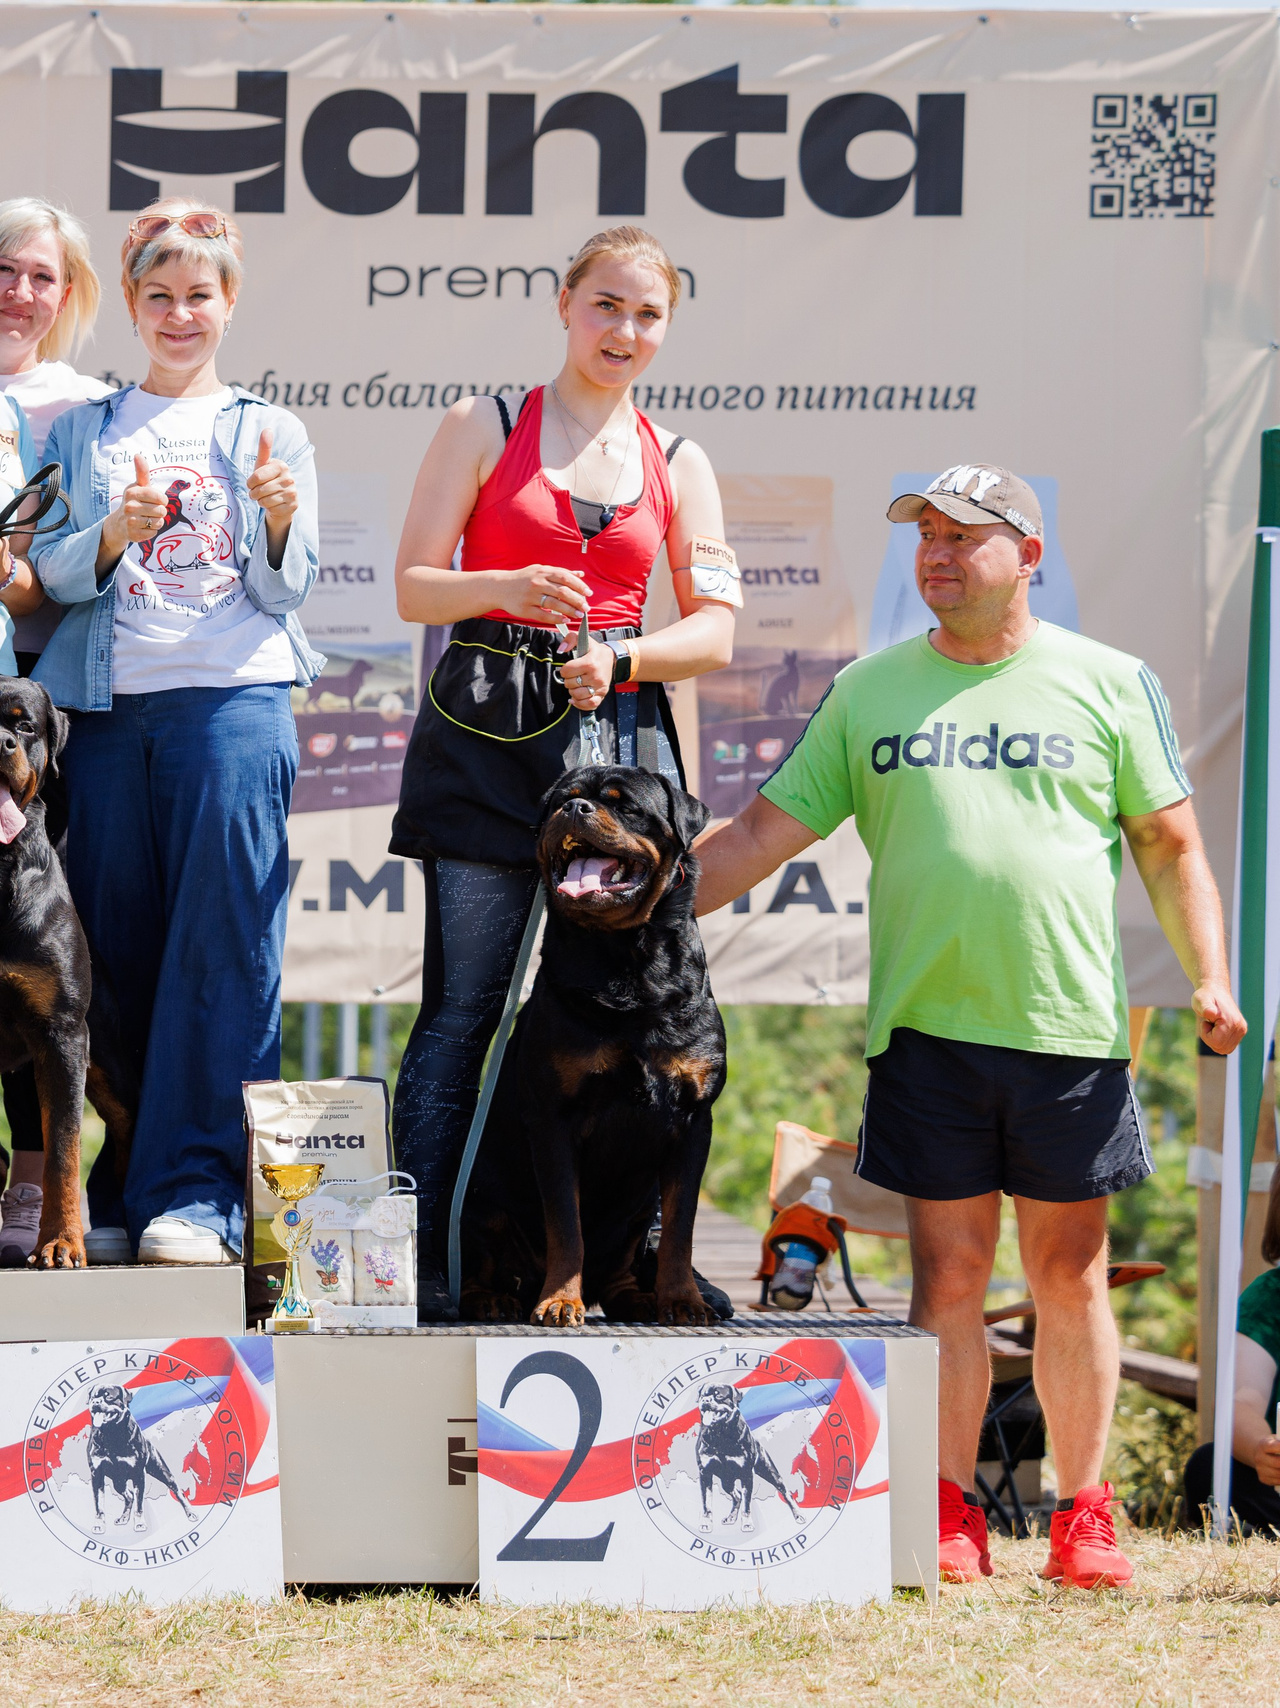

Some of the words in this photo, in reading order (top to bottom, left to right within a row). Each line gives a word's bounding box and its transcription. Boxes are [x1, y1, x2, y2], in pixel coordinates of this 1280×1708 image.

[109, 63, 966, 218] Hanta
[367, 254, 696, 307] prem
[776, 383, 977, 411] питания
[158, 437, 206, 450] Russia
[696, 543, 734, 565] Hanta
[163, 598, 196, 617] Cup
[871, 722, 1074, 774] adidas
[275, 1132, 365, 1150] Hanta
[28, 1358, 107, 1514] РОТВЕЙЛЕР
[125, 1353, 199, 1385] КЛУБ
[205, 1390, 243, 1508] РОССИИ
[636, 1357, 717, 1511] РОТВЕЙЛЕР
[736, 1352, 810, 1387] КЛУБ
[816, 1393, 852, 1512] РОССИИ
[497, 1350, 615, 1562] 2
[83, 1531, 200, 1566] РКФ-НКПР
[690, 1533, 808, 1566] РКФ-НКПР
